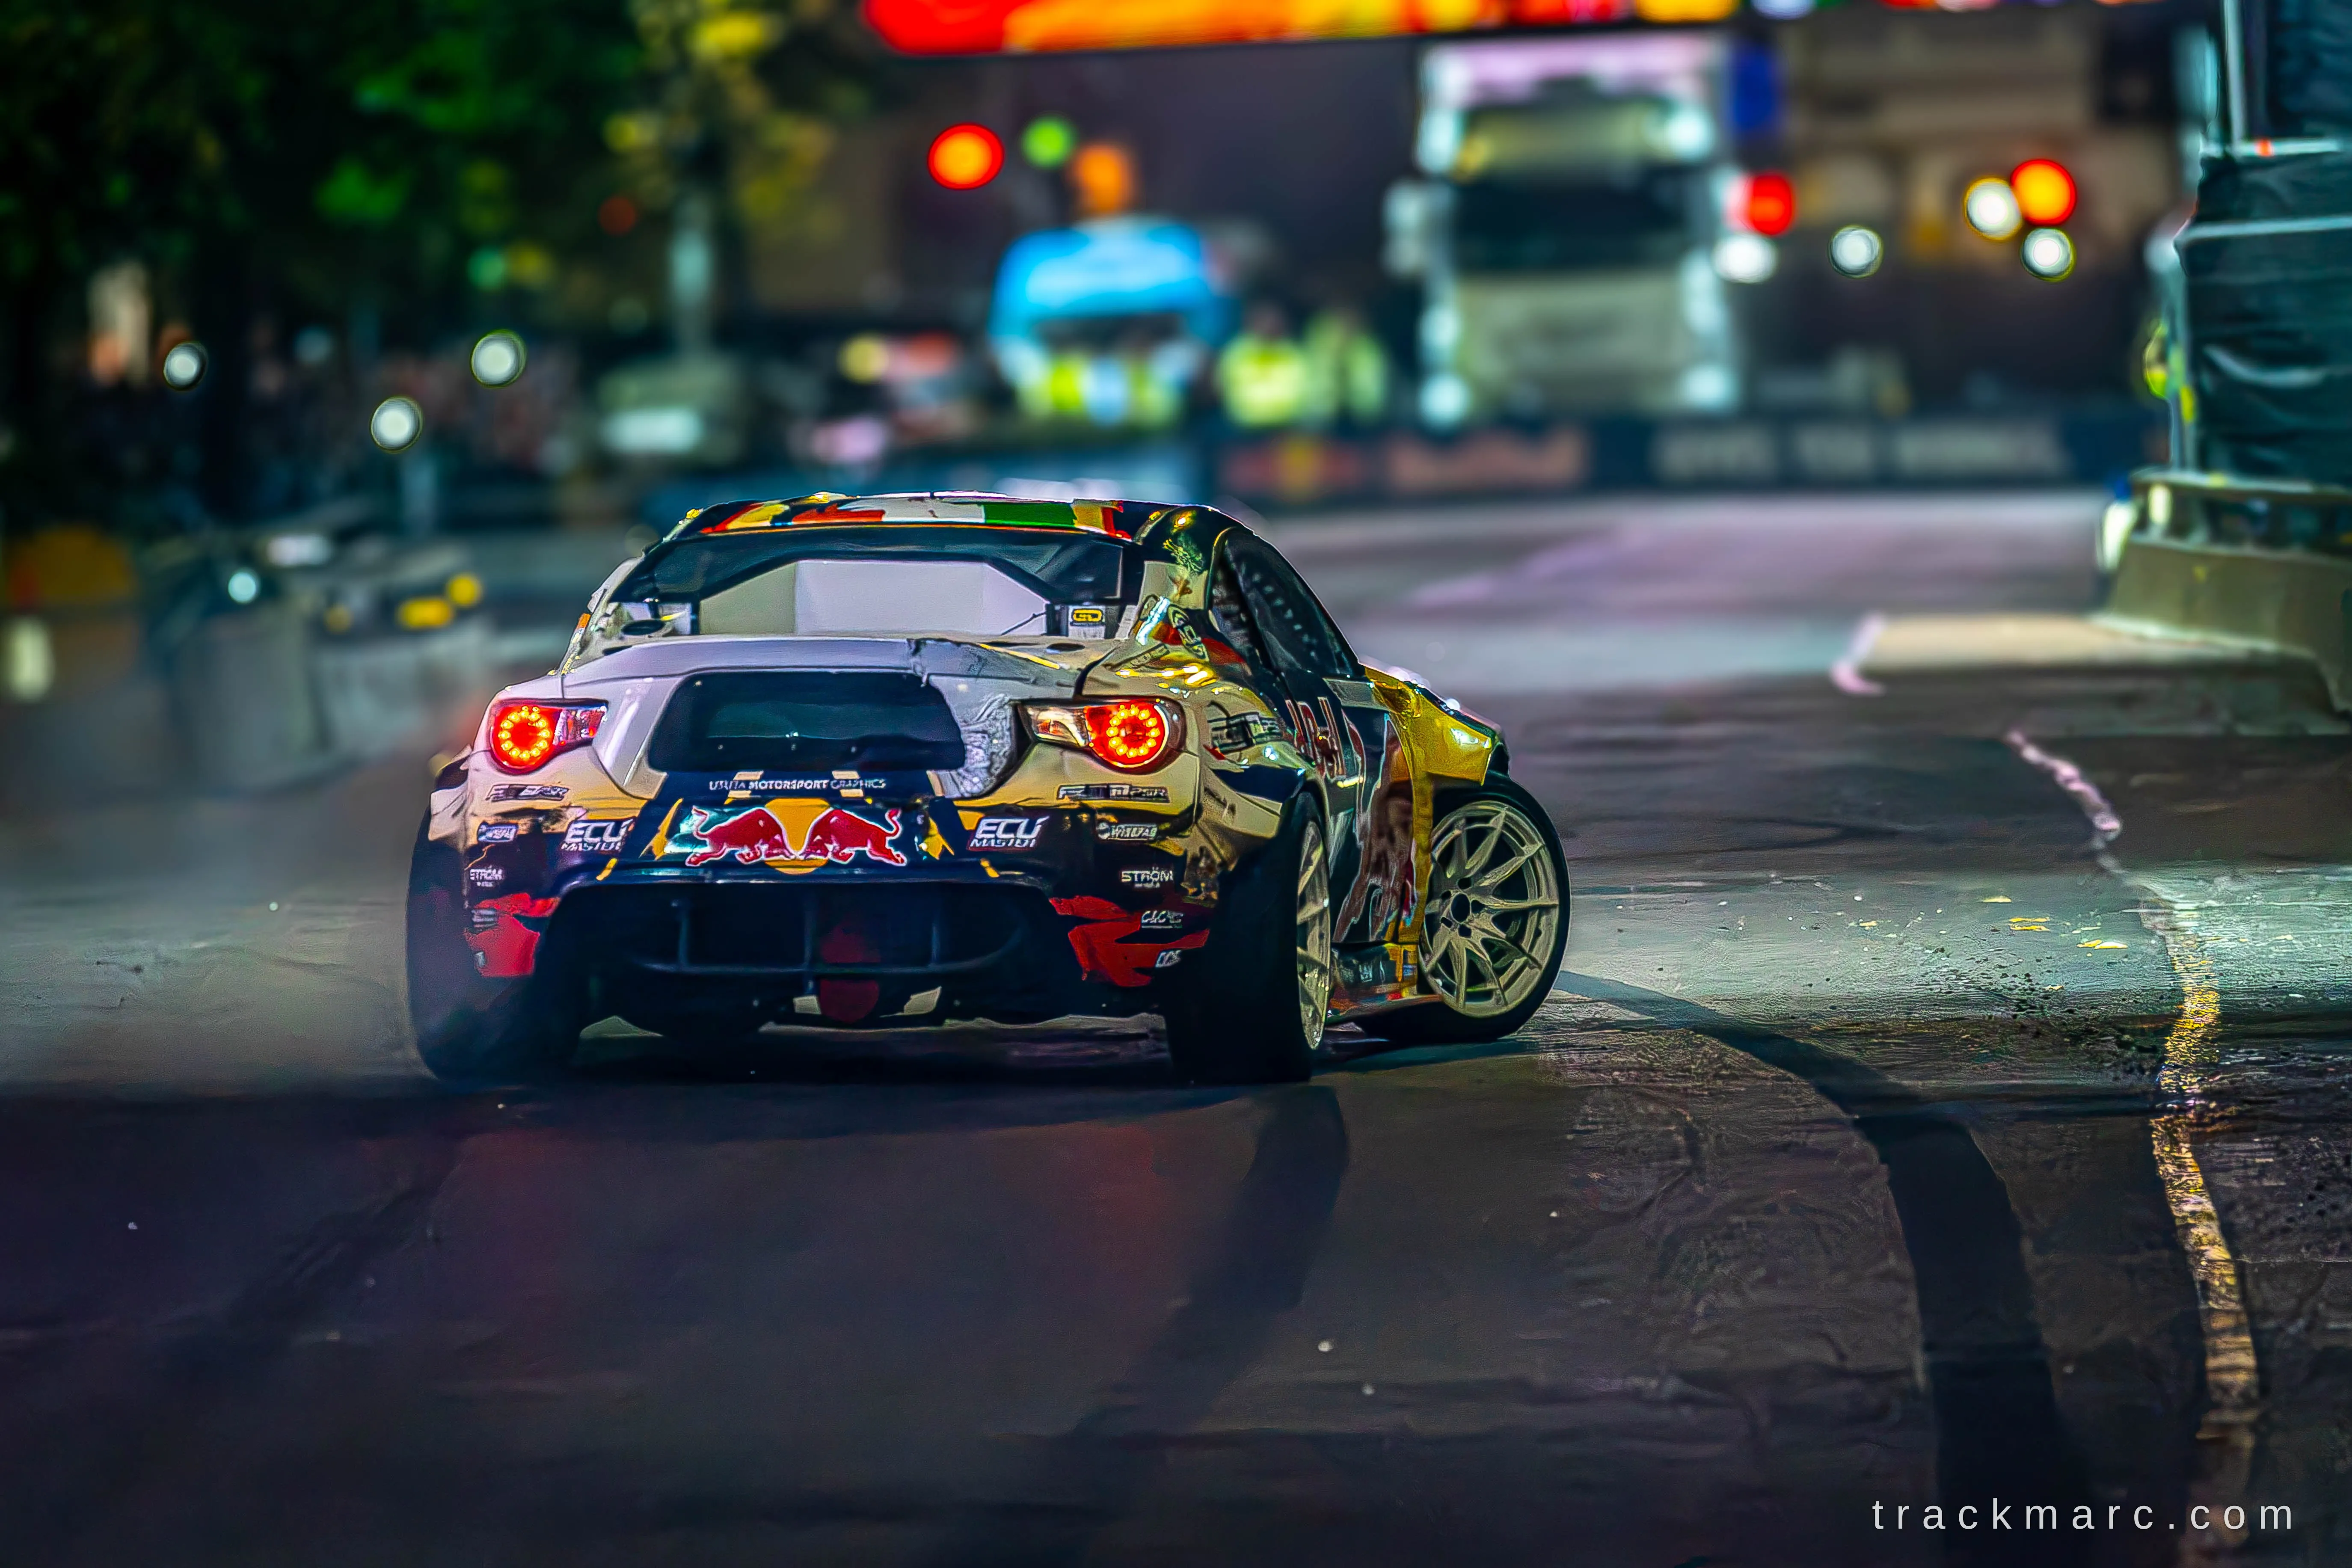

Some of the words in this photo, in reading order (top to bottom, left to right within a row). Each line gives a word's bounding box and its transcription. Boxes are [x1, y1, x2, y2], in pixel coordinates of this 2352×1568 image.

[749, 780, 829, 789] MOTORSPORT
[565, 819, 634, 843] ECU
[975, 816, 1050, 839] ECU
[1121, 867, 1173, 882] STRÖM
